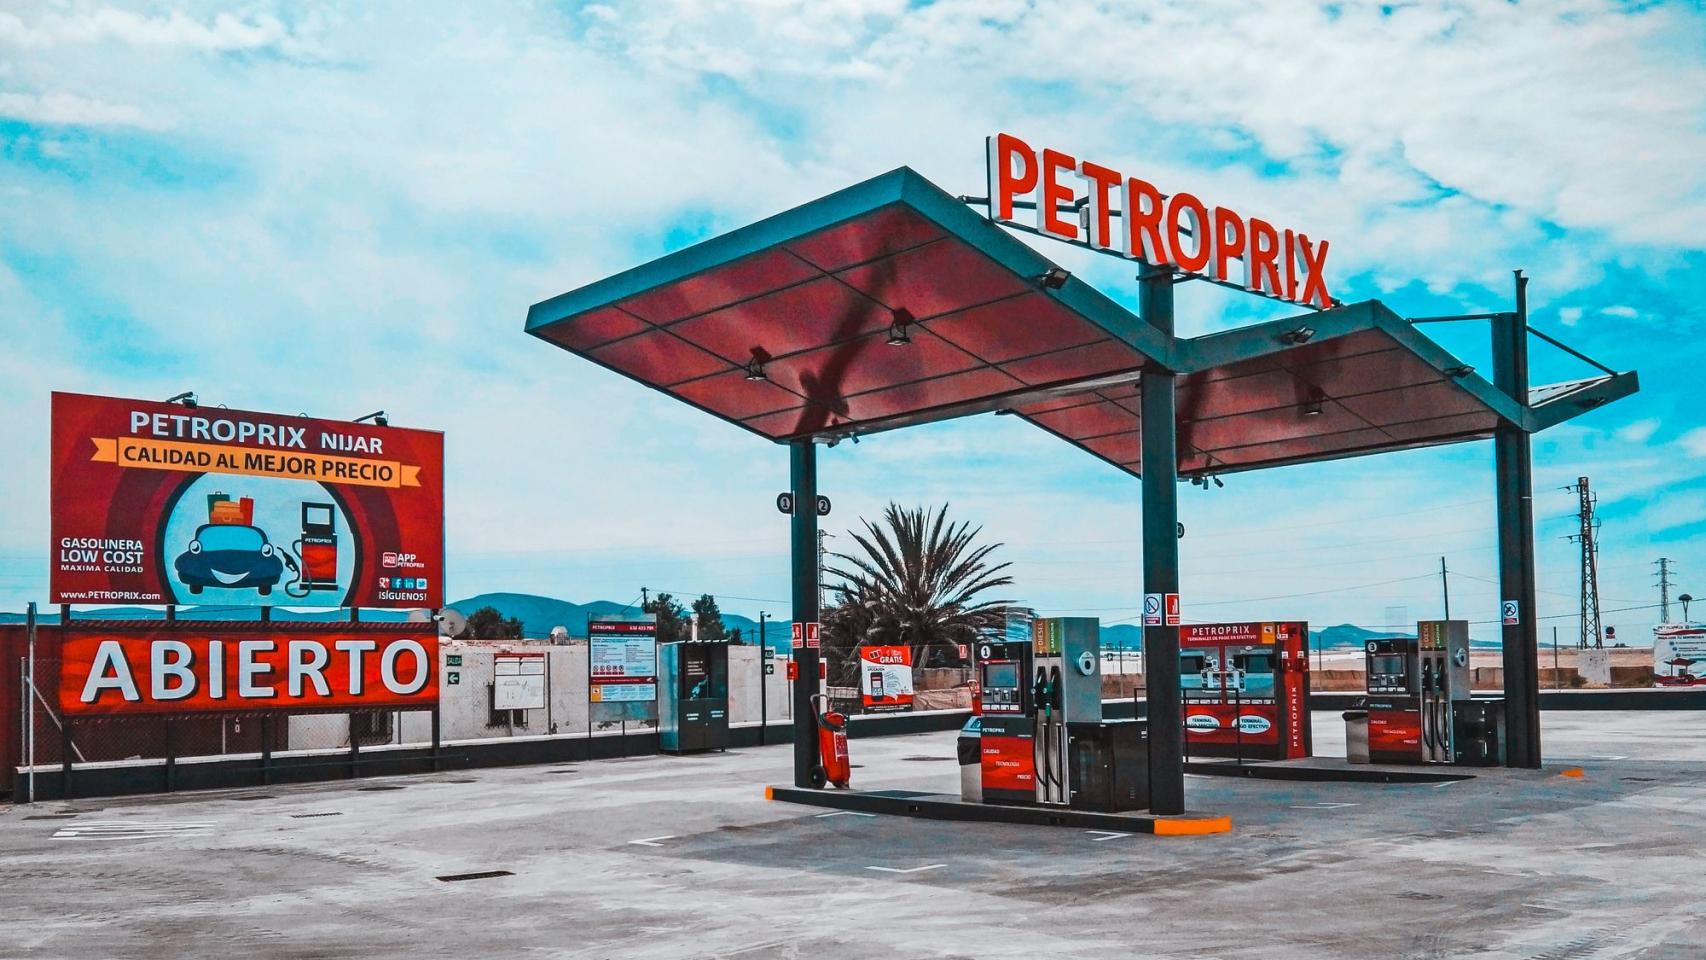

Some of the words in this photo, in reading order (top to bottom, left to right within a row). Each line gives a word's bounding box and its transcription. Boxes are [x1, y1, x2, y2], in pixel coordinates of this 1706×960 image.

[991, 132, 1332, 309] PETROPRIX
[130, 411, 306, 449] PETROPRIX
[321, 432, 383, 454] NIJAR
[124, 446, 211, 467] CALIDAD
[216, 453, 239, 469] AL
[244, 453, 316, 475] MEJOR
[322, 460, 393, 482] PRECIO
[61, 537, 143, 551] GASOLINERA
[61, 549, 98, 562] LOW
[103, 551, 144, 564] COST
[398, 553, 417, 562] APP
[60, 564, 101, 572] MAXIMA
[104, 565, 144, 573] CALIDAD
[60, 590, 160, 600] www.PETROPRIX.com
[1192, 625, 1250, 636] PETROPRIX
[880, 656, 903, 664] GRATIS
[80, 640, 429, 702] ABIERTO
